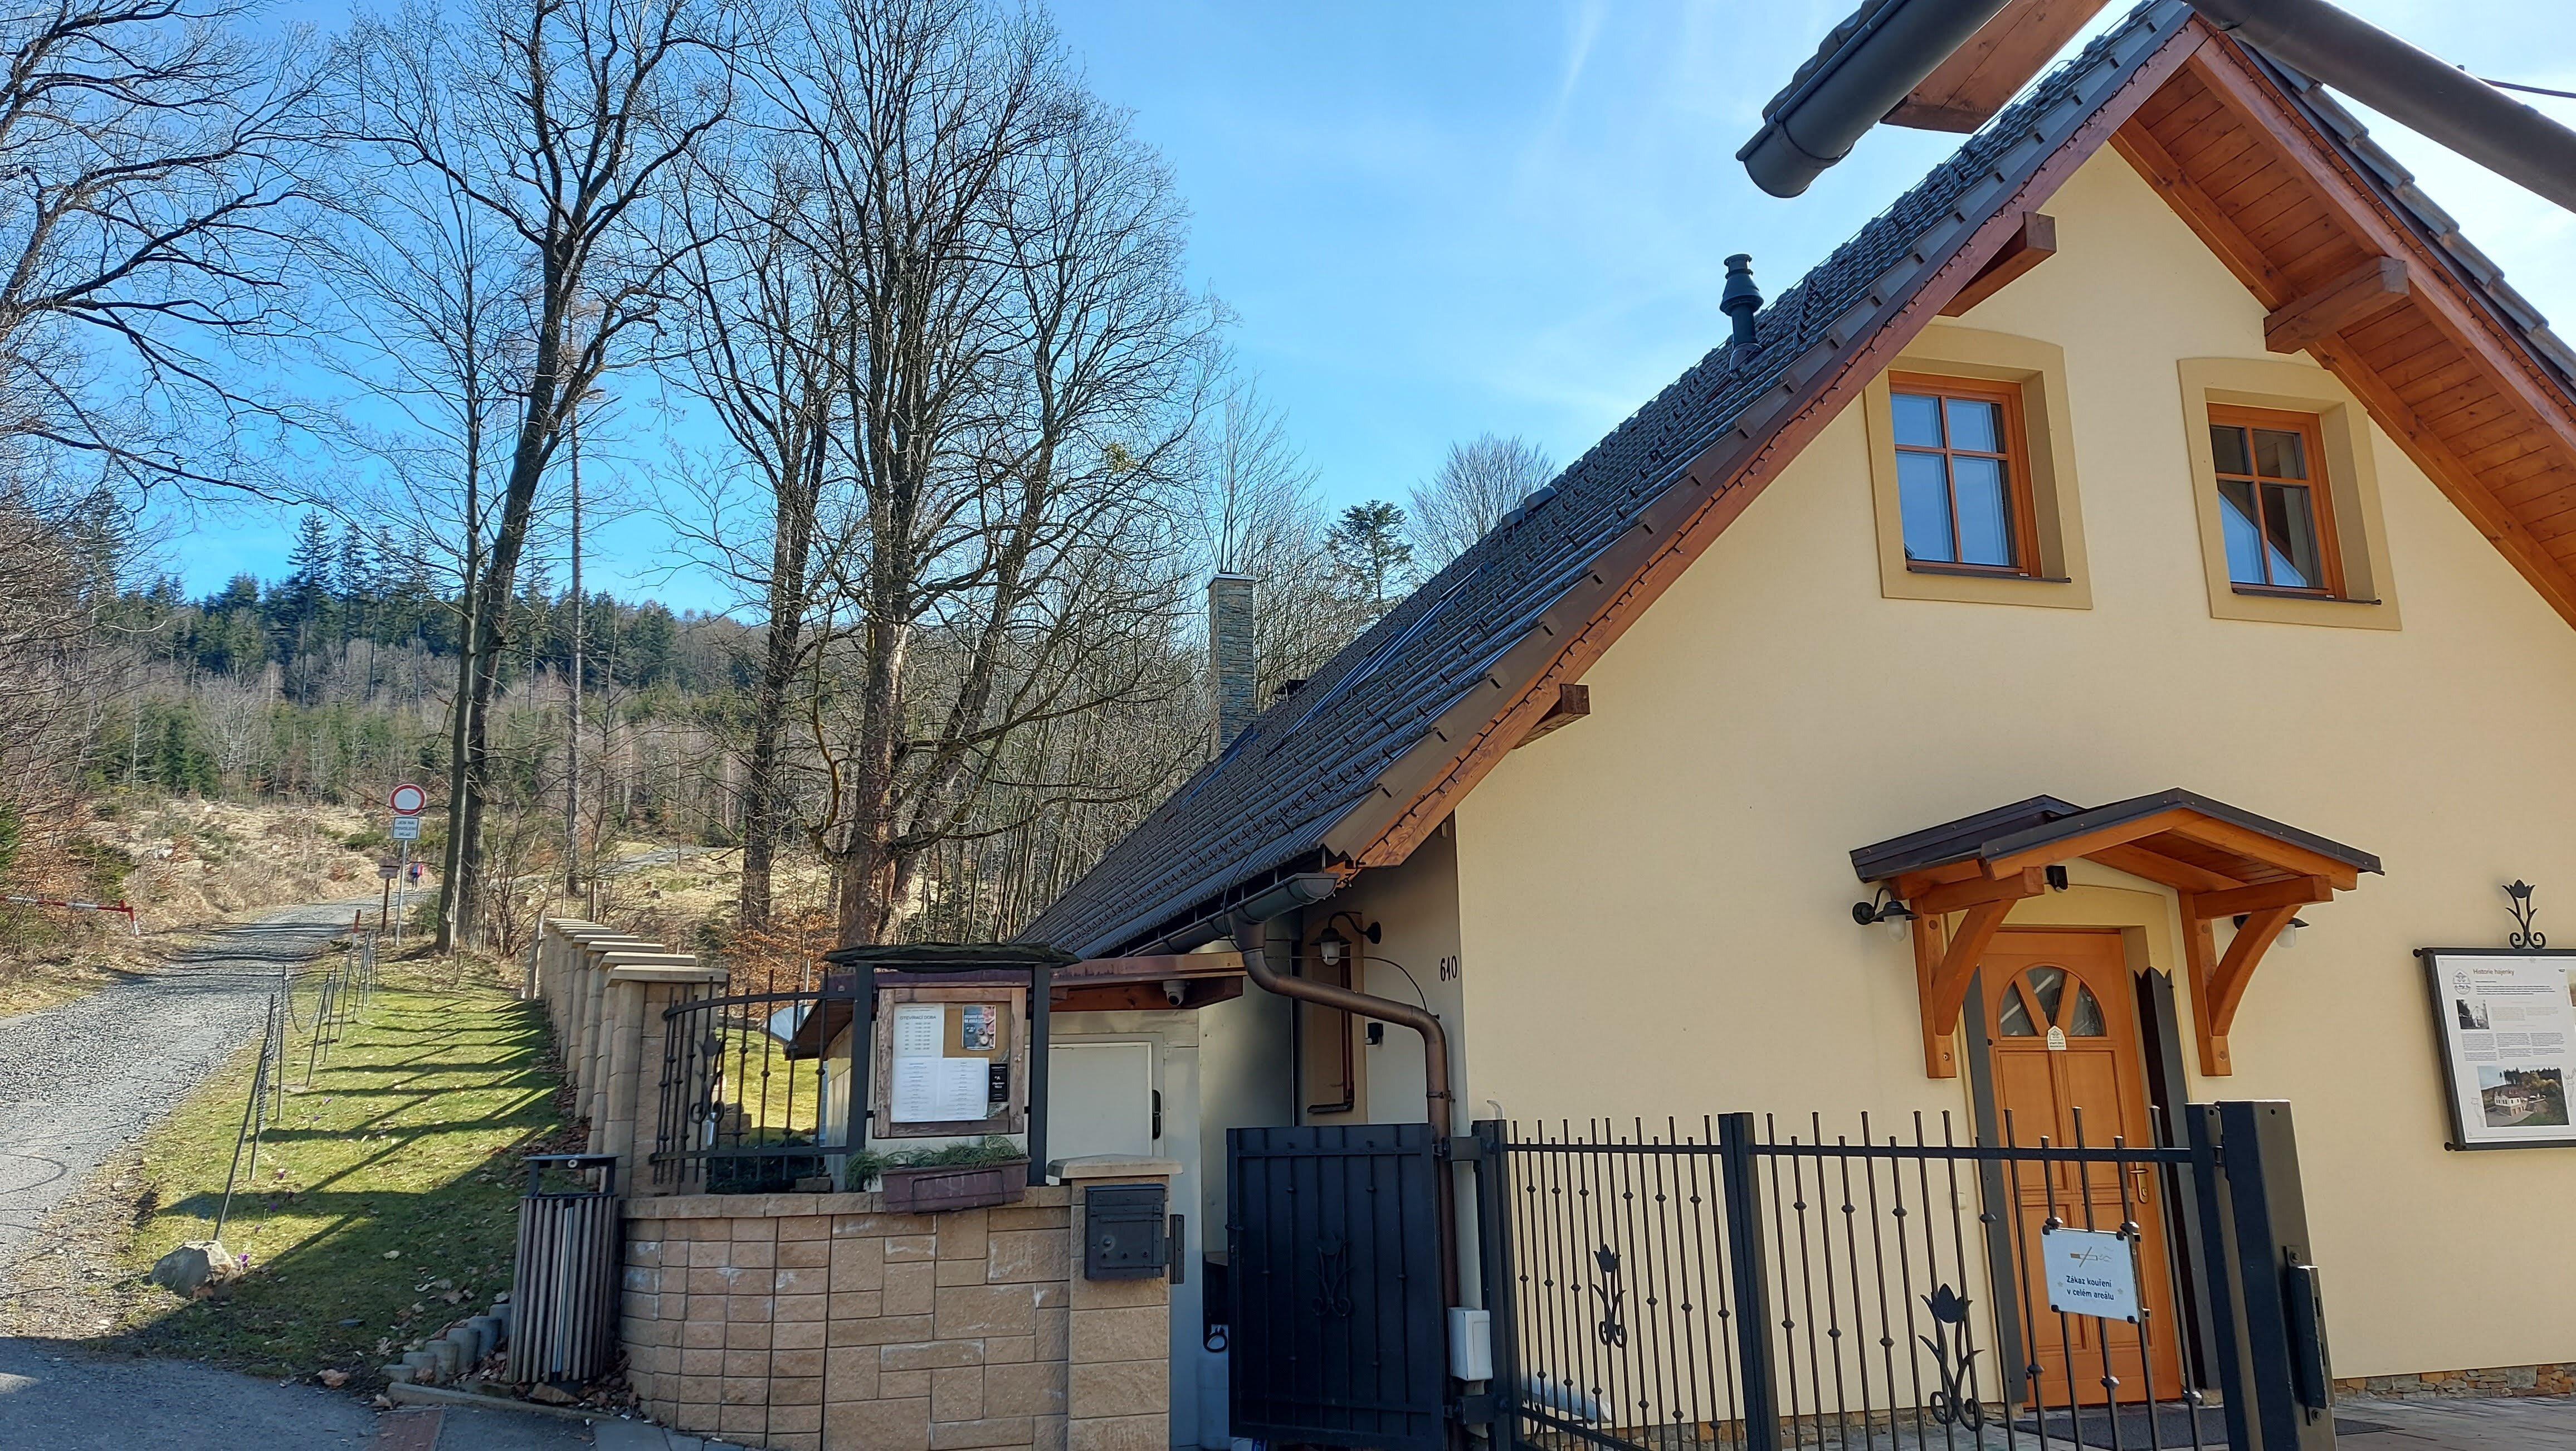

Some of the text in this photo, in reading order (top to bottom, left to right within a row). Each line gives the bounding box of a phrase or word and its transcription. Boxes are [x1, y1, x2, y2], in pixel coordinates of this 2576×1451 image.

[1440, 955, 1457, 982] 610
[2066, 1275, 2112, 1288] Zákaz kouření
[2073, 1288, 2092, 1298] celém
[2094, 1291, 2115, 1300] areálu
